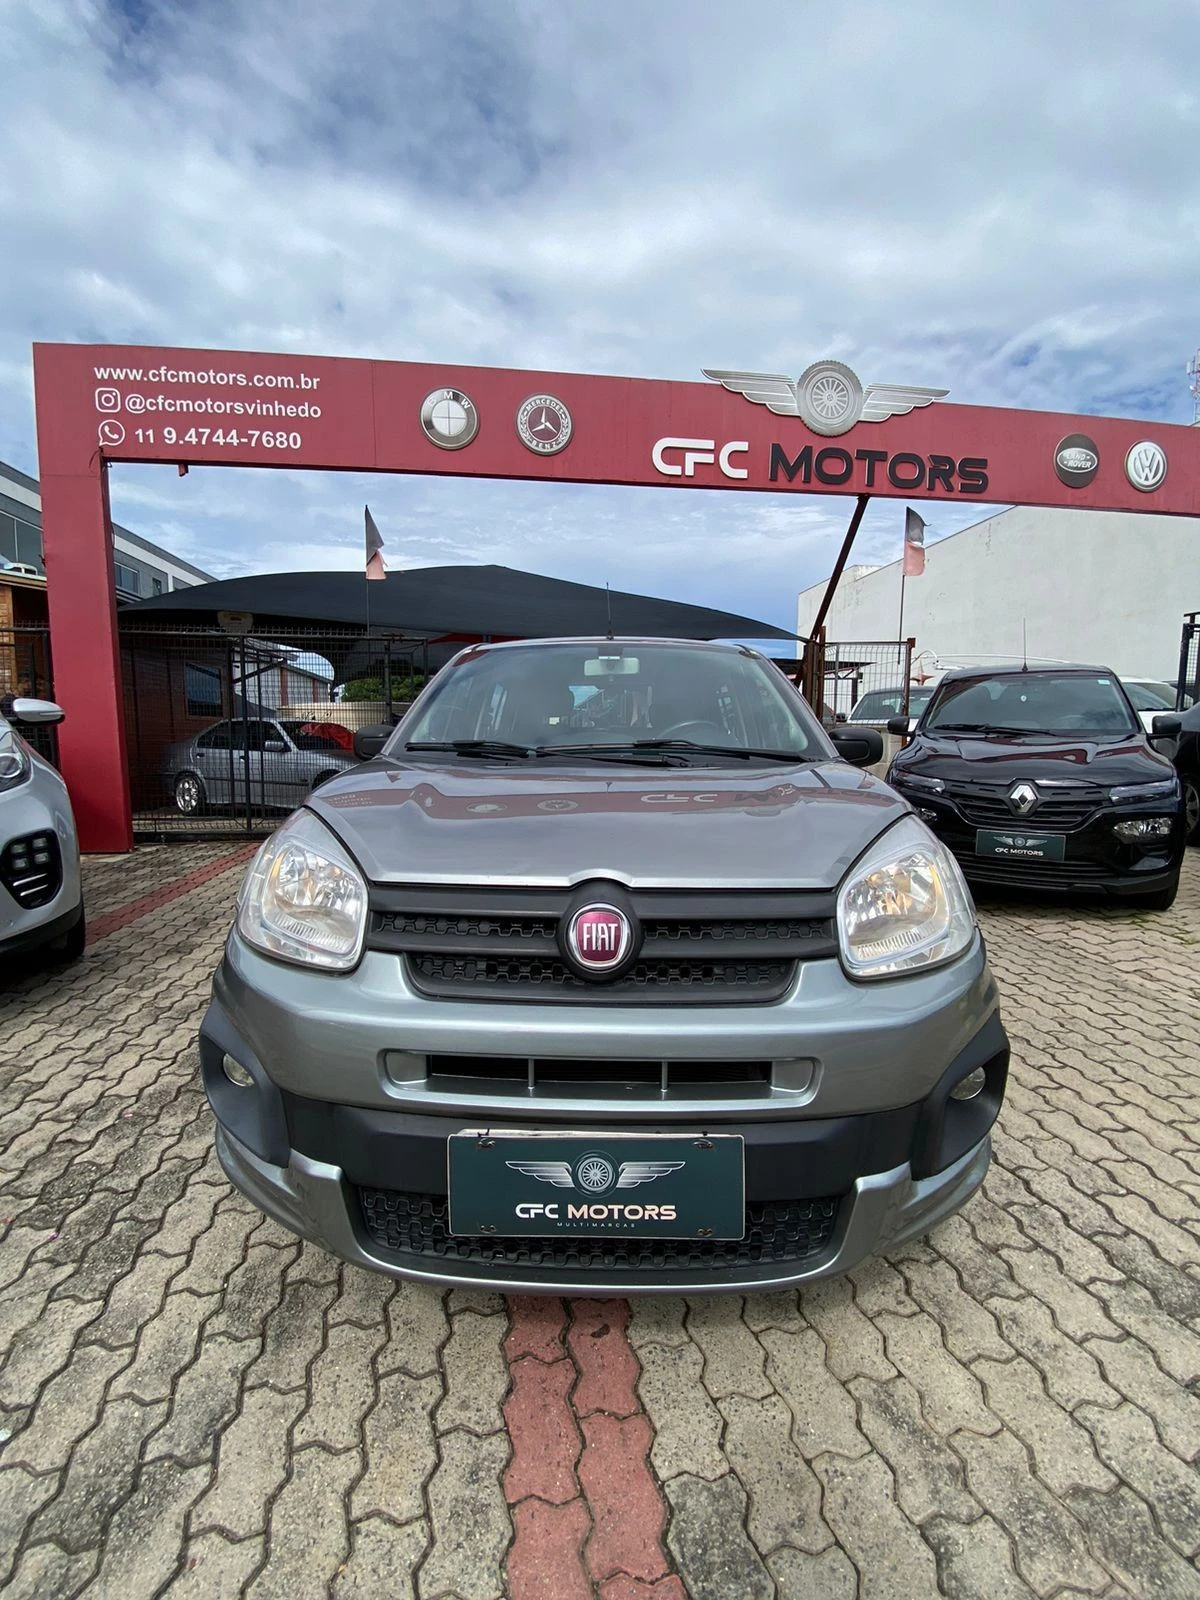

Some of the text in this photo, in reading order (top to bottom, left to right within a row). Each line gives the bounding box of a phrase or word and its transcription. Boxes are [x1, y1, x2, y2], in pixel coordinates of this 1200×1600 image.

[94, 366, 320, 390] www.cfcmotors.com.br
[125, 393, 322, 418] @cfcmotorsvinhedo
[134, 427, 302, 449] 11 9.4744-7680
[651, 436, 990, 494] CFC MOTORS
[1010, 848, 1044, 857] MOTORS
[582, 922, 619, 951] FIAT
[515, 1203, 677, 1220] CFC MOTORS
